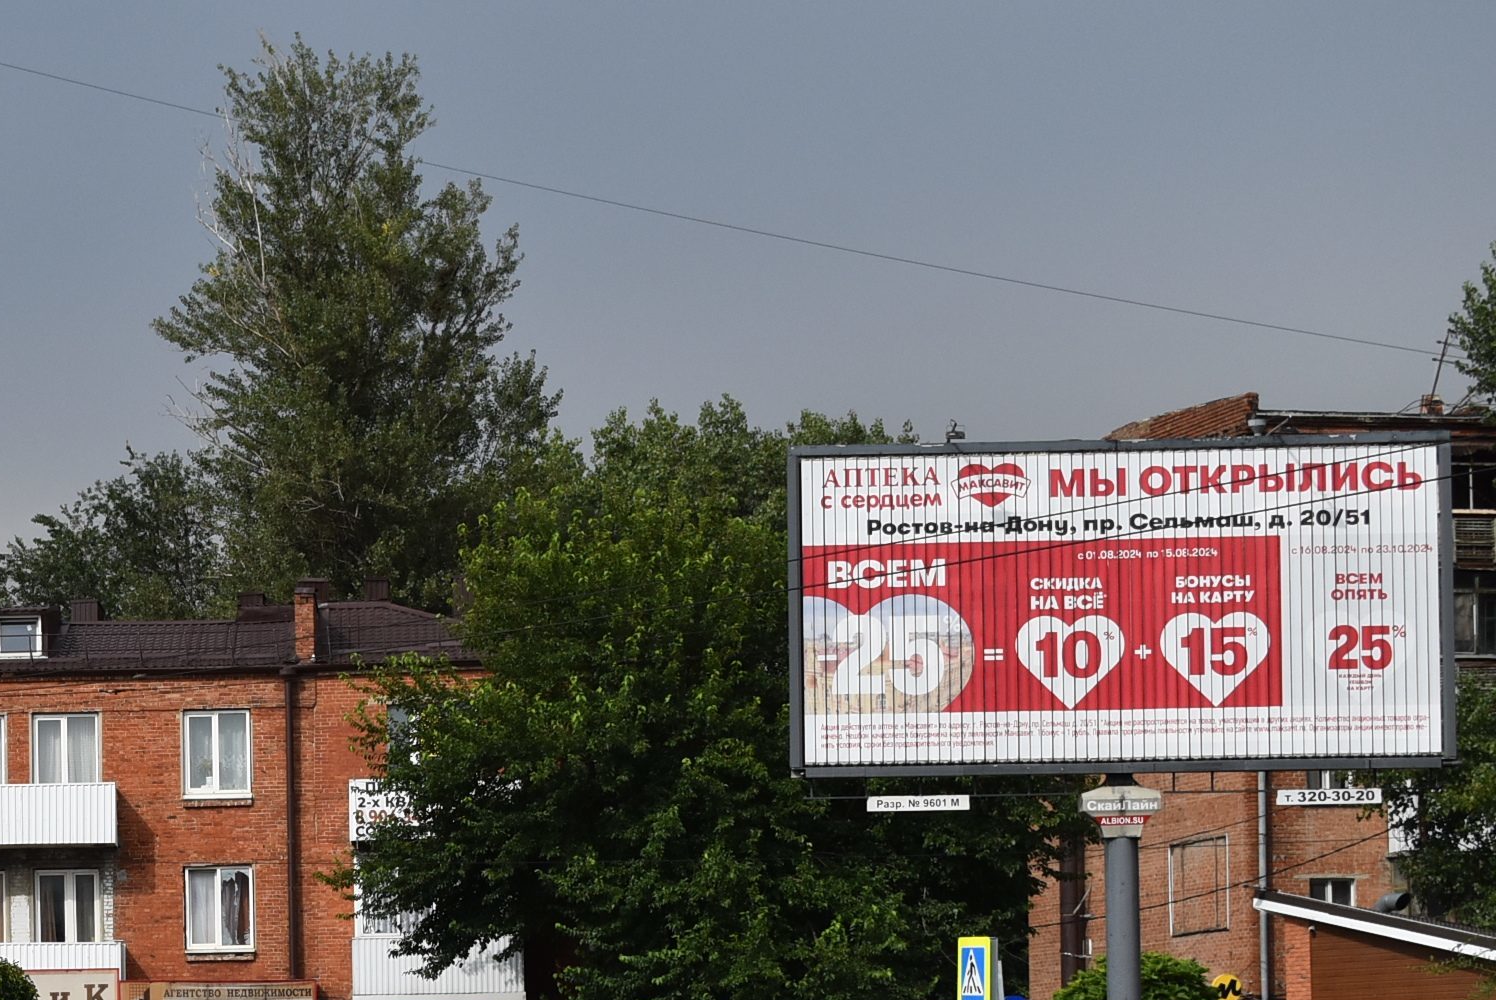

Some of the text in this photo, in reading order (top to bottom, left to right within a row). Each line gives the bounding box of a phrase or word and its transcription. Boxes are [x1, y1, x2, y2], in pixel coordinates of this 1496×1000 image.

[821, 466, 941, 488] АПТЕКА
[1049, 461, 1423, 498] МЫ ОТКРЫЛИСЬ
[958, 478, 1025, 492] МАКСАВИТ
[820, 492, 942, 512] с сердцем
[866, 510, 1371, 536] Ростов-на-Дону, пр. Сельмаш, д. 20/51
[1146, 550, 1159, 558] по
[1160, 548, 1218, 558] 5.08.2024
[1361, 546, 1374, 554] по
[1376, 544, 1433, 554] 23.10.2024
[827, 558, 946, 589] ВСЕМ
[1335, 572, 1383, 585] ВСЕМ
[1030, 576, 1103, 591] СКИДКА
[1175, 574, 1251, 588] БОНУСЫ
[1171, 590, 1255, 604] НА КАРТУ
[1330, 588, 1388, 601] ОПЯТЬ
[1030, 595, 1059, 610] НА
[1297, 790, 1375, 803] 320-30-20
[876, 798, 960, 810] Разр. № 9601 М
[1086, 800, 1159, 811] СкайЛайн
[1100, 816, 1145, 825] ALBION.SU
[164, 987, 312, 998] АГЕНТСТВО НЕДВИЖИМОСТИ
